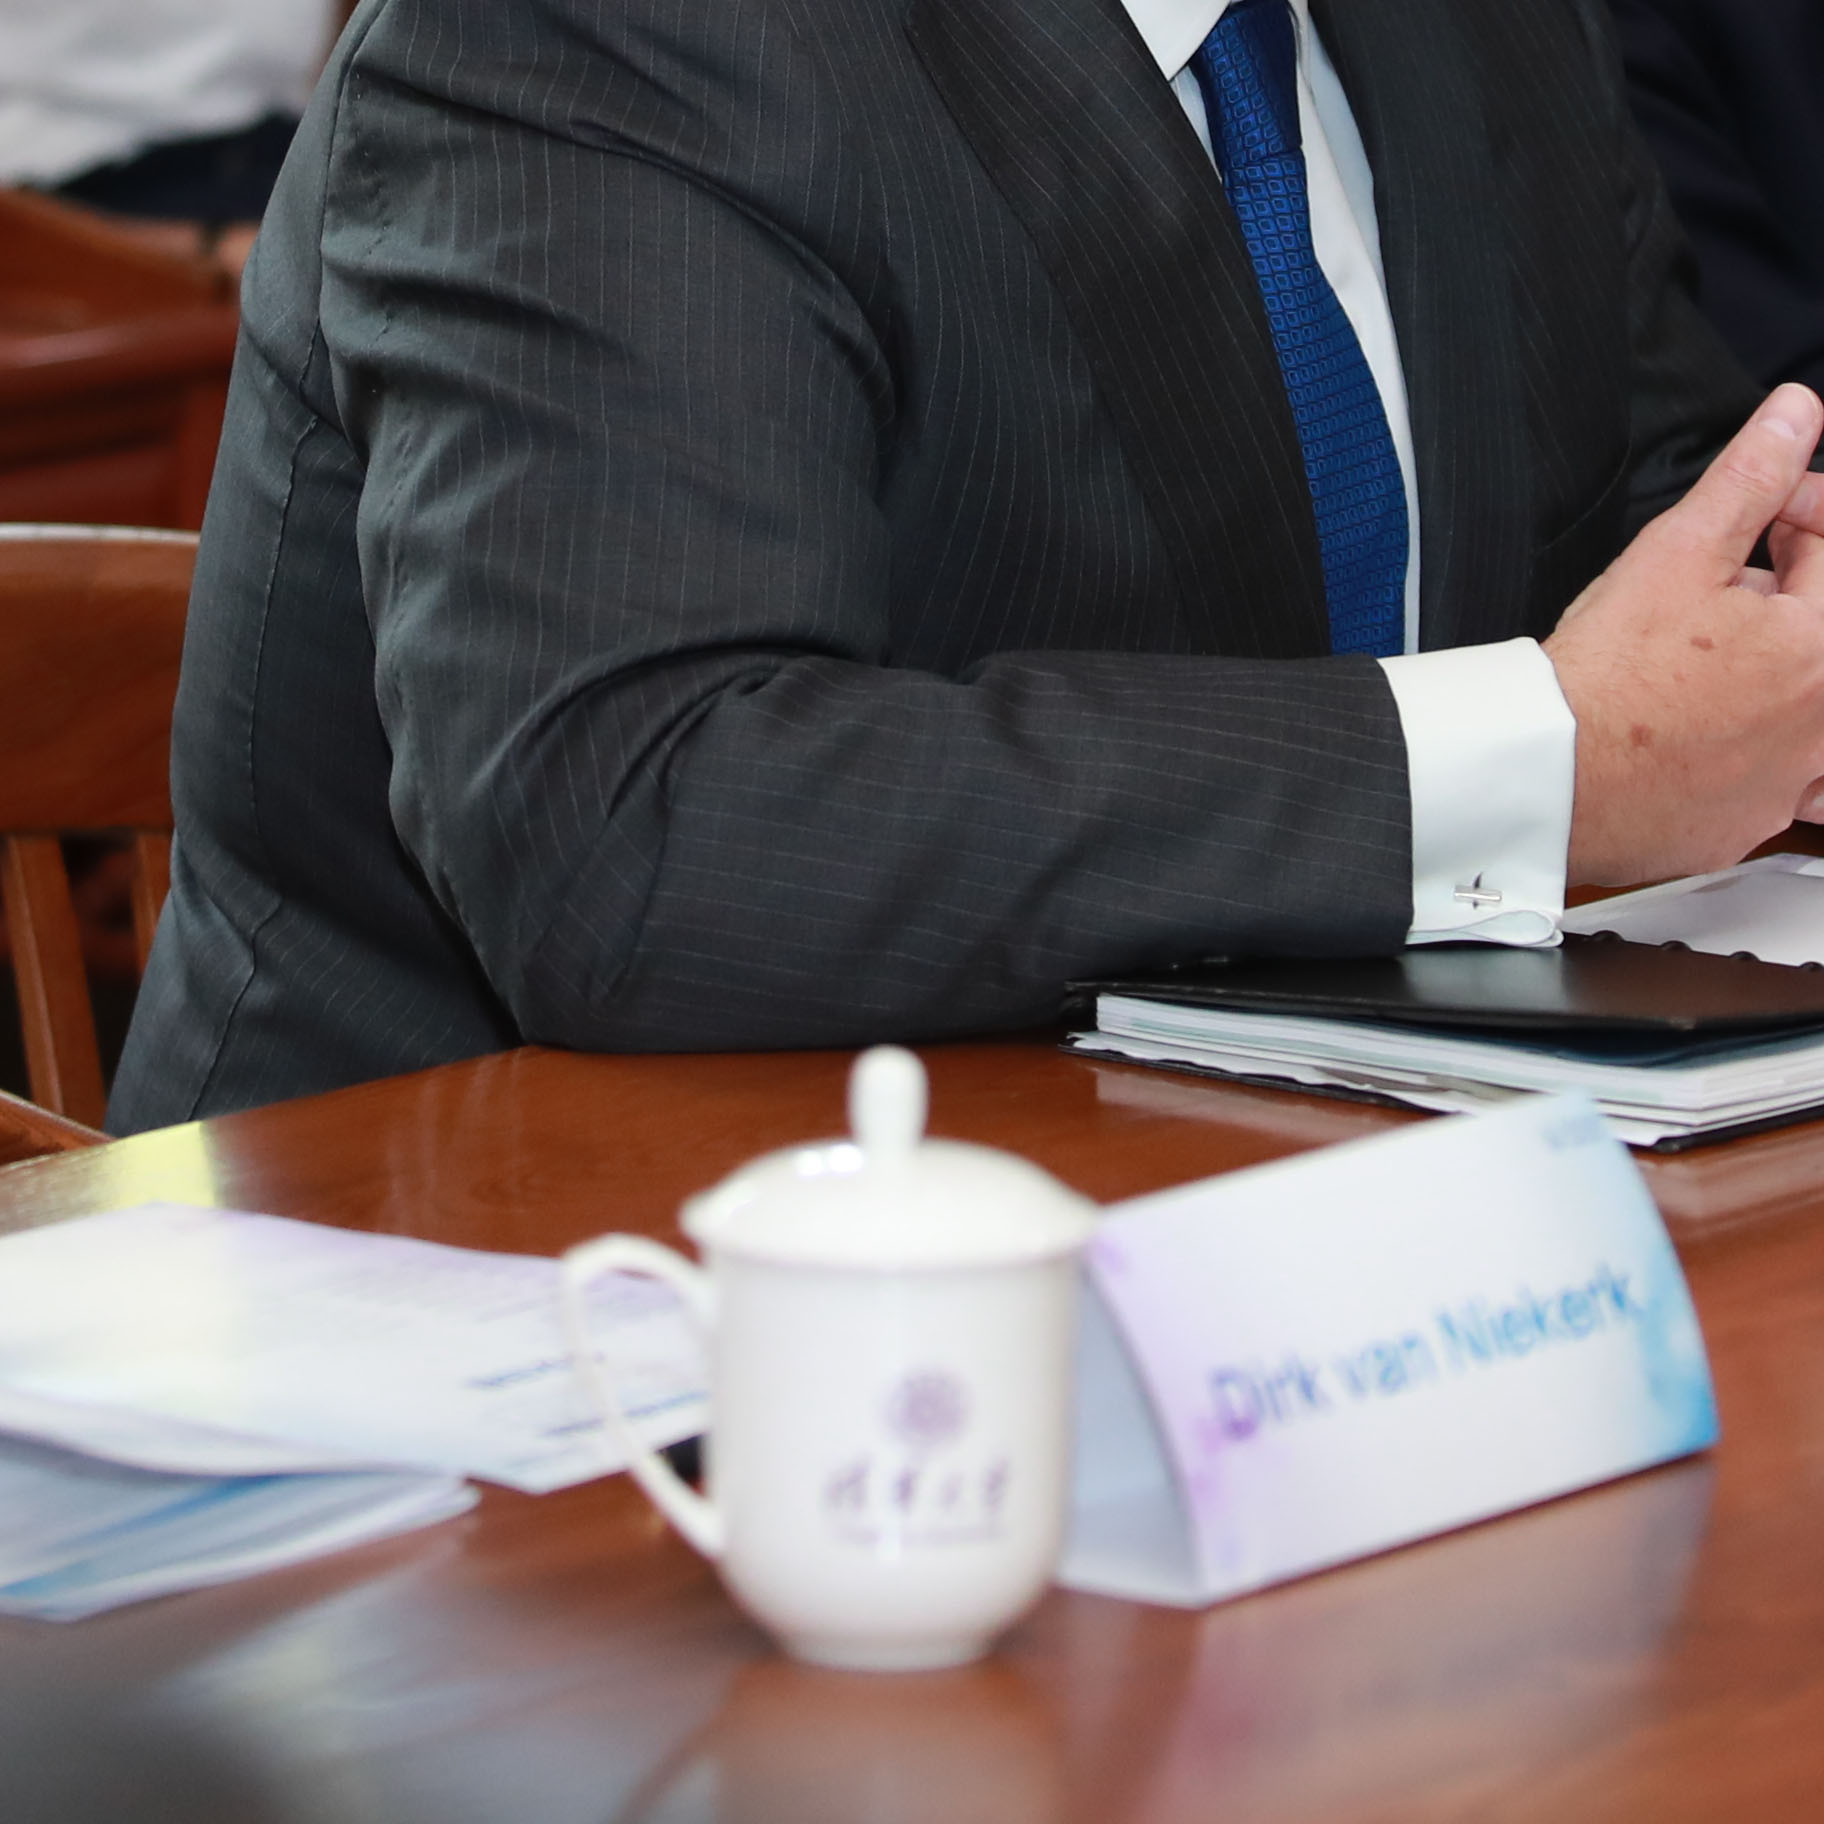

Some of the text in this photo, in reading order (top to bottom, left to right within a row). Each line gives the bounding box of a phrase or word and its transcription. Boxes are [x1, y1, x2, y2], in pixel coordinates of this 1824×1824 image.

[1209, 1262, 1642, 1439] Dirk van Niekerk
